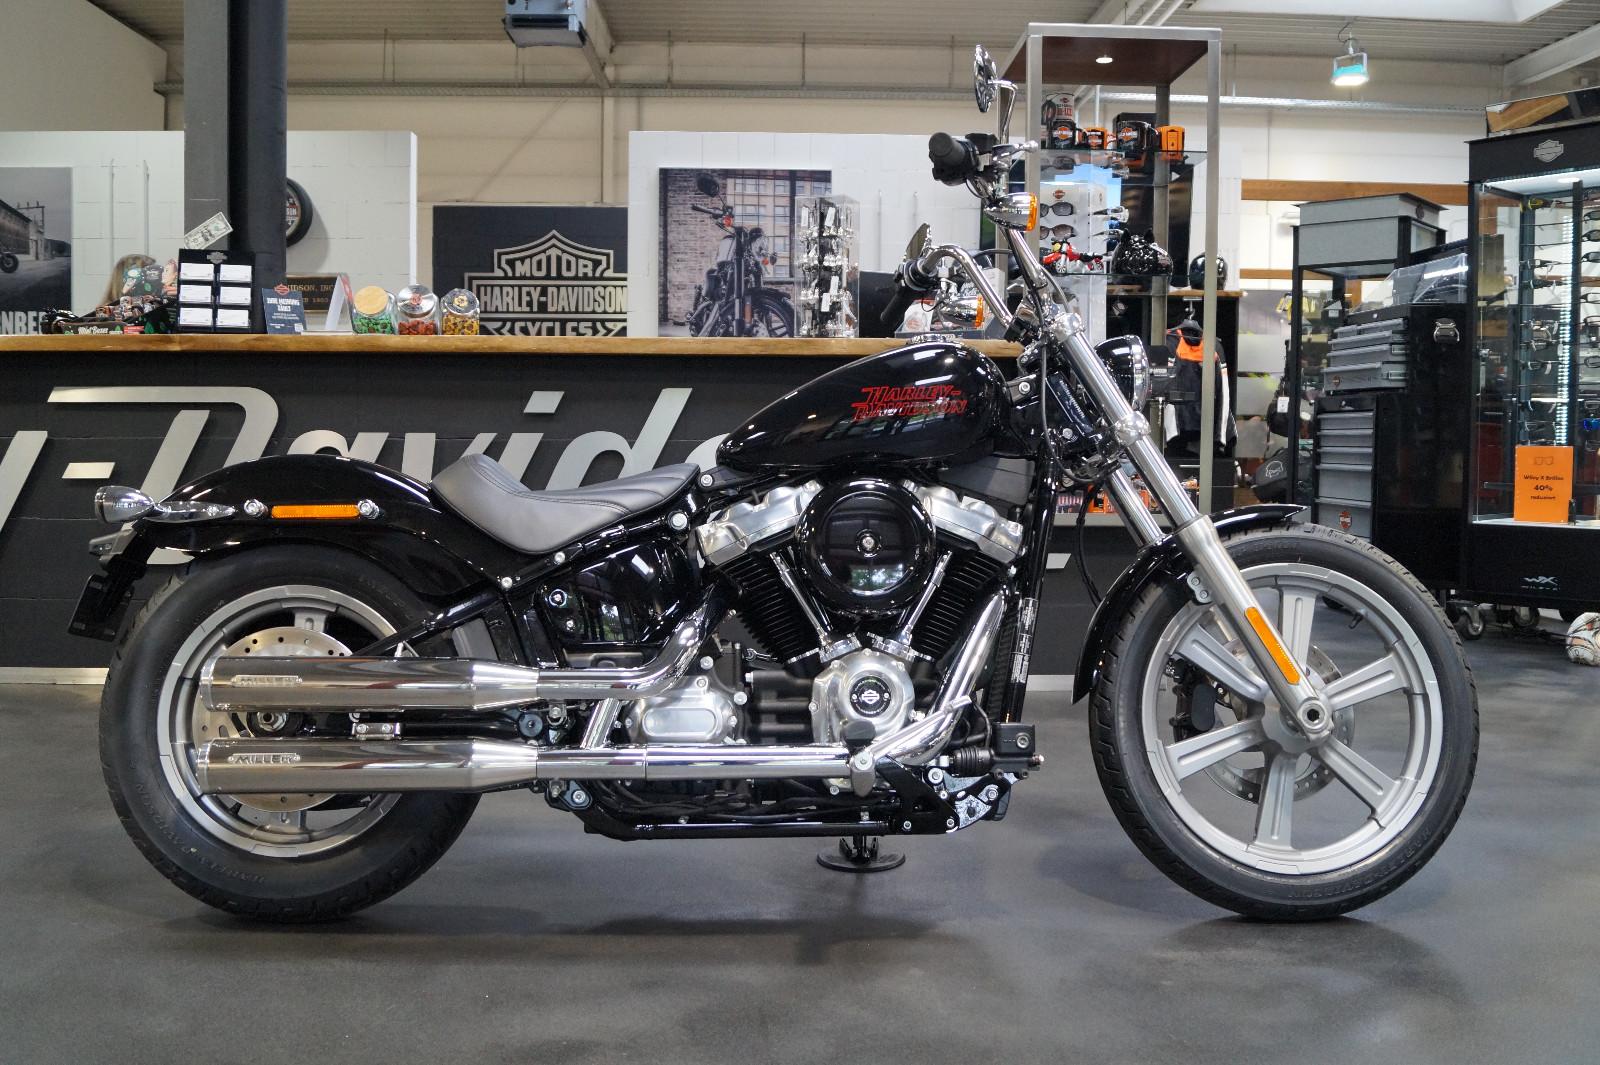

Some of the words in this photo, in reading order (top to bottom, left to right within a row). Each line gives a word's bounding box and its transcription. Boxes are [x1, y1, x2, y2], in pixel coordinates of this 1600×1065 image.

[515, 247, 593, 277] MOTOR
[480, 286, 627, 312] HARLEY-DAVIDSON
[860, 385, 961, 404] HARLEY-
[1533, 484, 1553, 492] 40%
